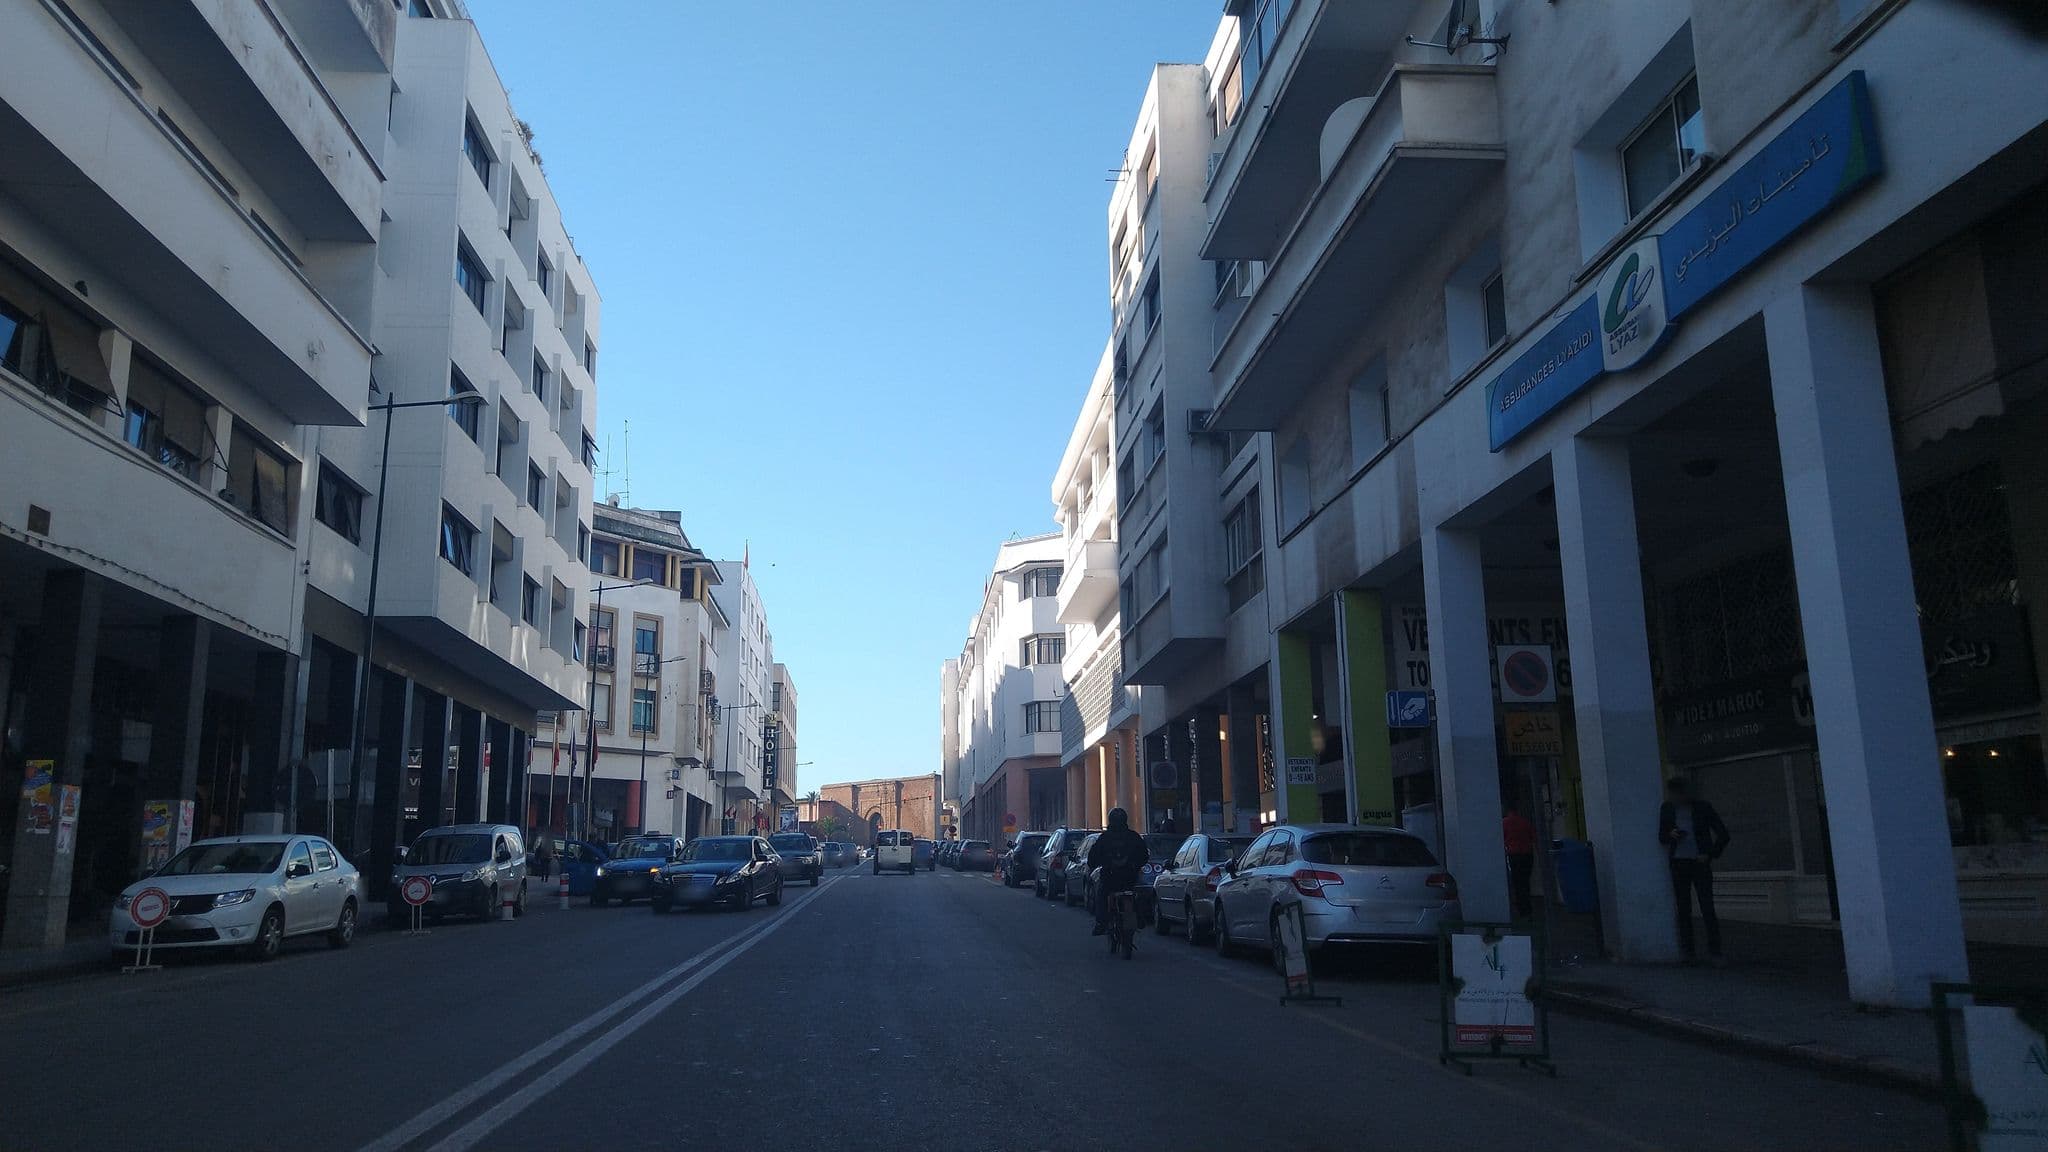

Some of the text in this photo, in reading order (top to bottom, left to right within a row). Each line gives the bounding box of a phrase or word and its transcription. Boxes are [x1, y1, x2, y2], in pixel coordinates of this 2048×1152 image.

[1610, 324, 1640, 356] LYAZ
[1500, 329, 1594, 412] ASSURANCES LYAZIDI
[1718, 690, 1764, 718] MAROC
[765, 728, 776, 788] HÔTEL
[1362, 810, 1393, 820] gugus
